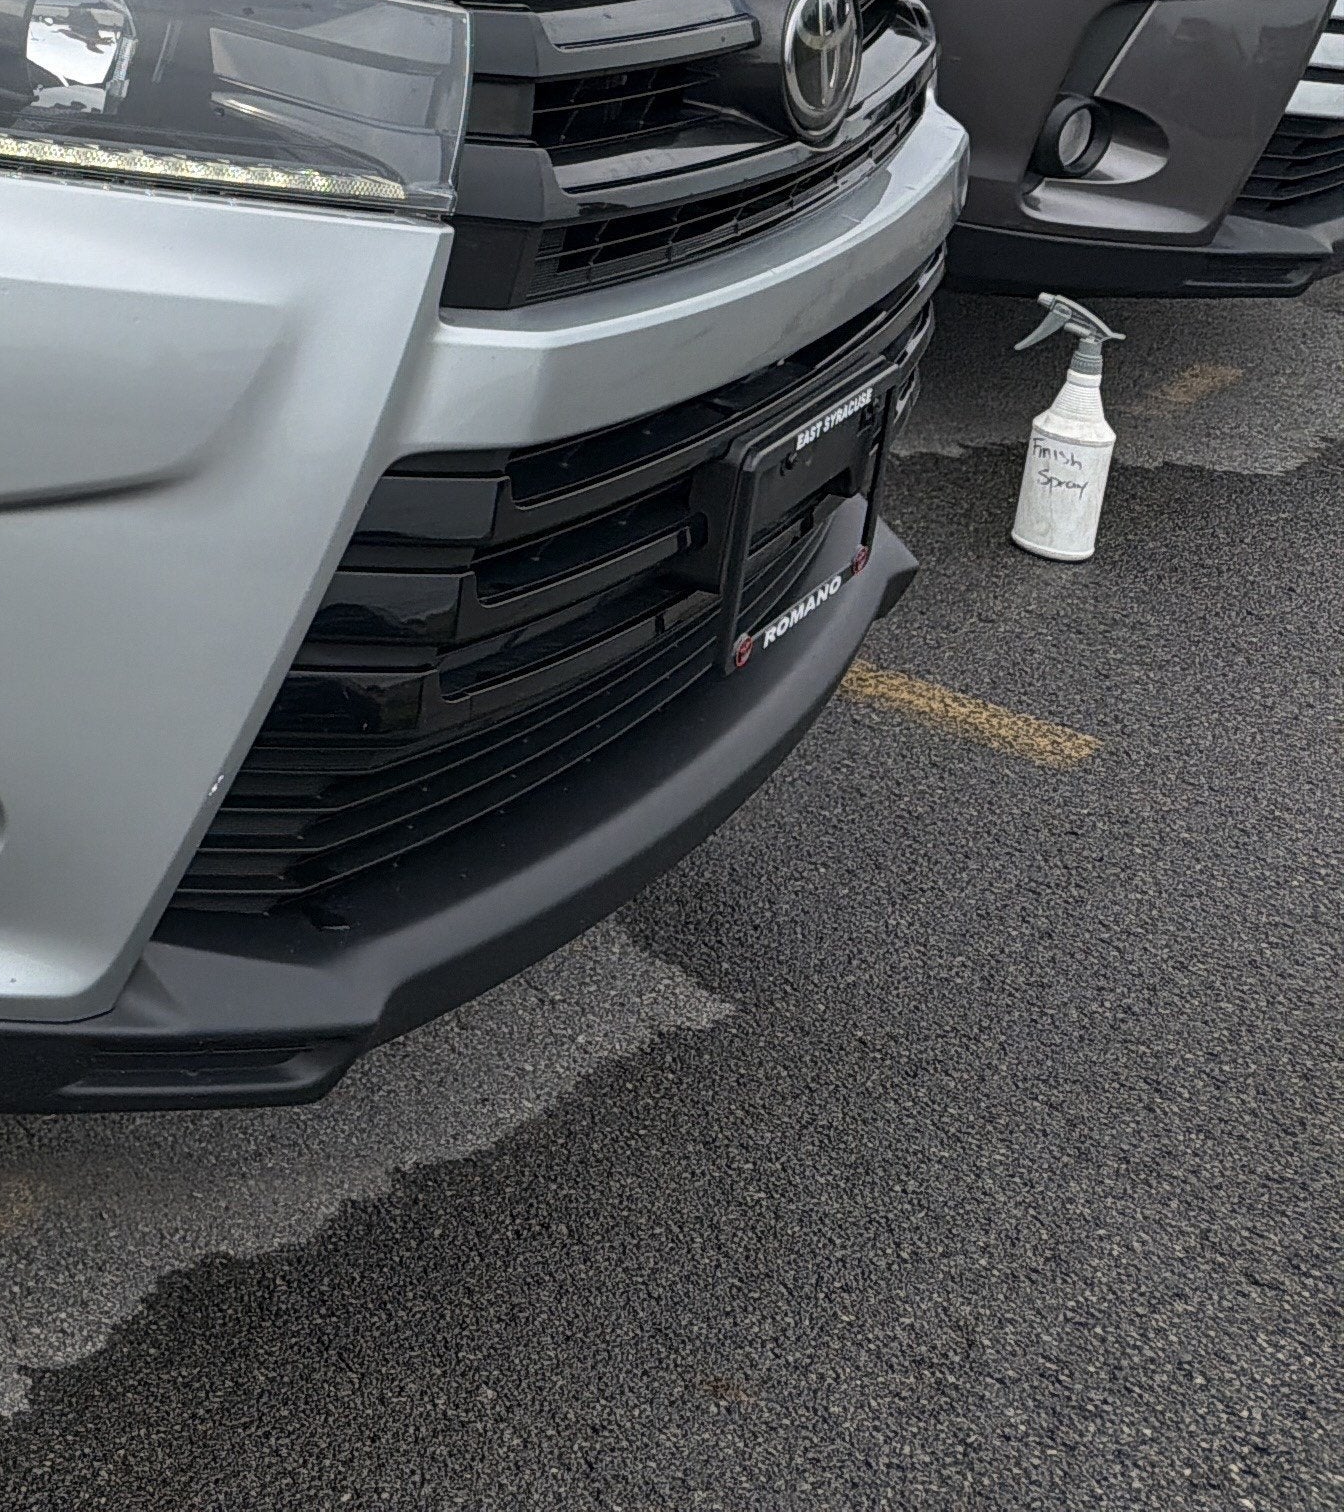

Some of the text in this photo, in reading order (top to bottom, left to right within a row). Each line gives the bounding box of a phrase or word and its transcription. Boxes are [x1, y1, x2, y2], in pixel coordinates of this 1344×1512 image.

[796, 388, 873, 450] EAST SYRACUSE
[1032, 437, 1082, 470] Finish
[763, 576, 842, 649] ROMANO
